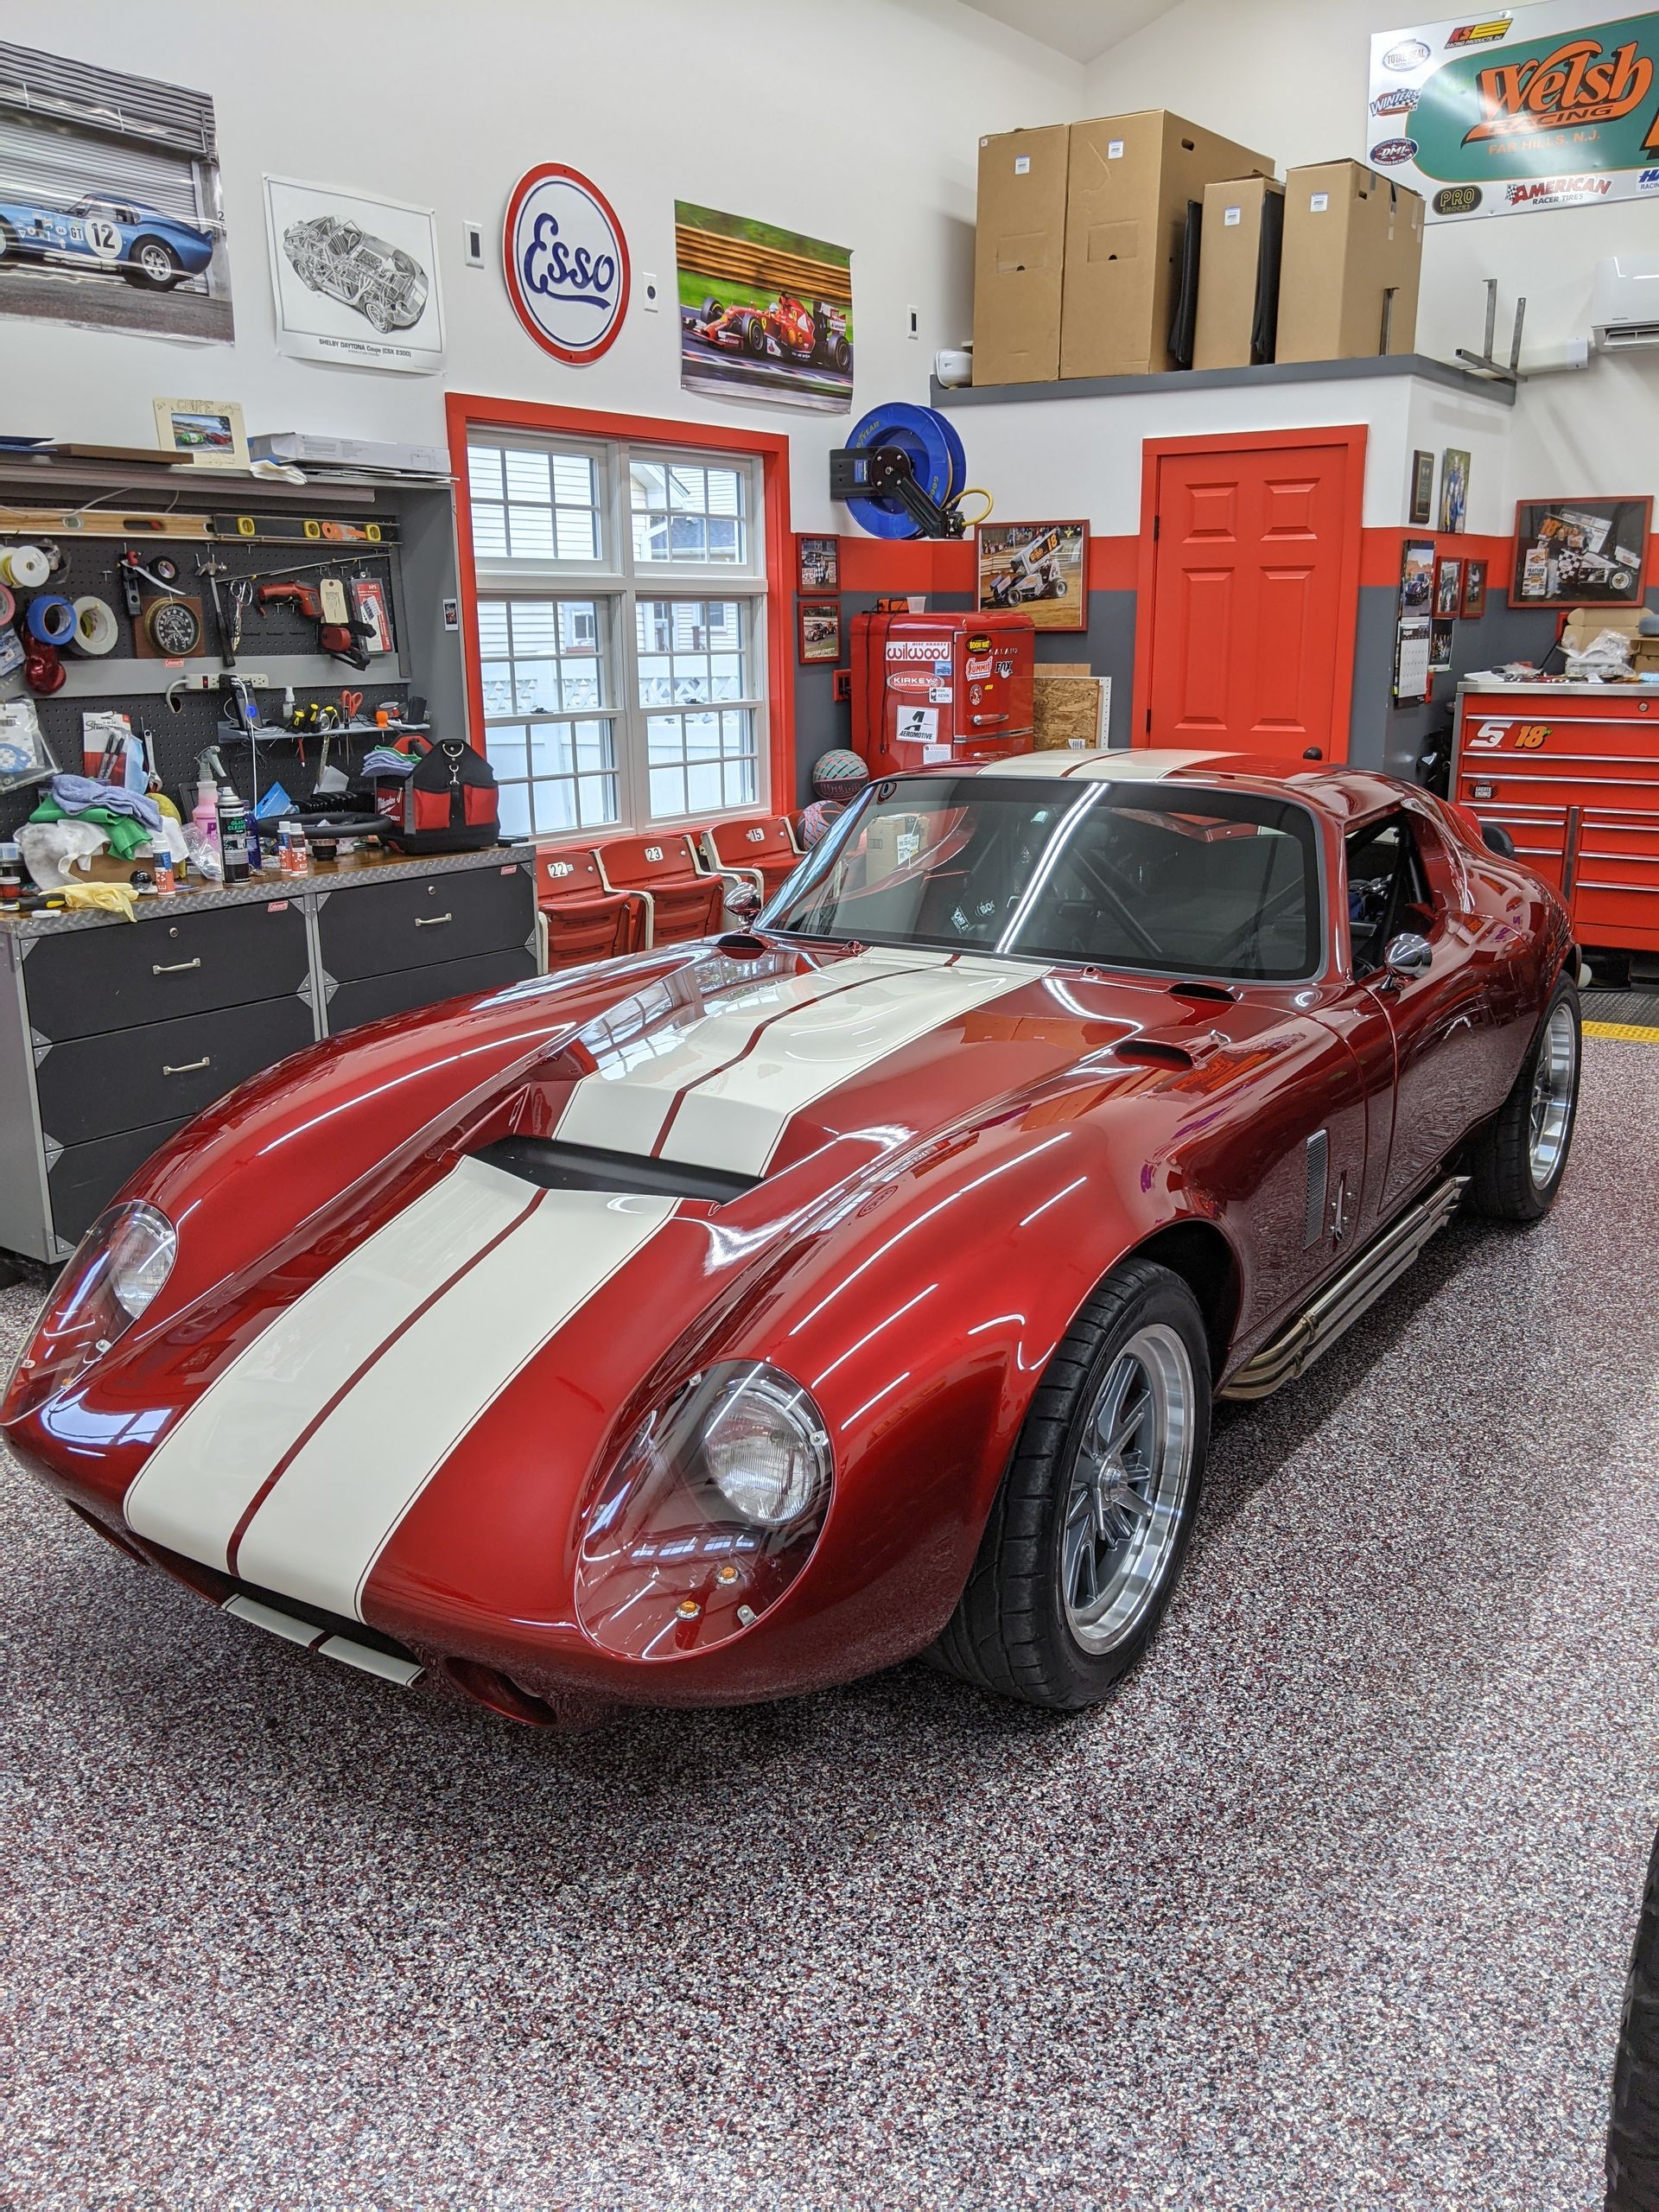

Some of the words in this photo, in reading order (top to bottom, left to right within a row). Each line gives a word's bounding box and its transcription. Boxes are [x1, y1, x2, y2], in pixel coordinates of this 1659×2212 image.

[1477, 39, 1654, 121] Welsh
[1370, 90, 1420, 117] WINTERS
[1491, 104, 1614, 133] RACING
[1381, 145, 1407, 156] DMI
[1489, 143, 1518, 156] FAR
[1440, 188, 1475, 207] PRO
[1511, 177, 1612, 206] AMERICAN
[1532, 196, 1560, 205] RACER
[1561, 193, 1585, 202] TIRES
[218, 210, 225, 222] 2
[70, 226, 85, 242] GT
[91, 222, 117, 250] 12
[524, 213, 615, 294] Esso
[319, 338, 340, 347] SHELBY
[340, 341, 366, 352] DAYTONA
[366, 345, 381, 353] Coupe
[1046, 533, 1058, 550] 18
[887, 642, 950, 660] wilwood
[899, 730, 933, 740] AEROMOTIVE
[1514, 725, 1548, 749] 18
[751, 829, 762, 840] 15
[647, 848, 661, 861] 23
[550, 863, 566, 877] 22
